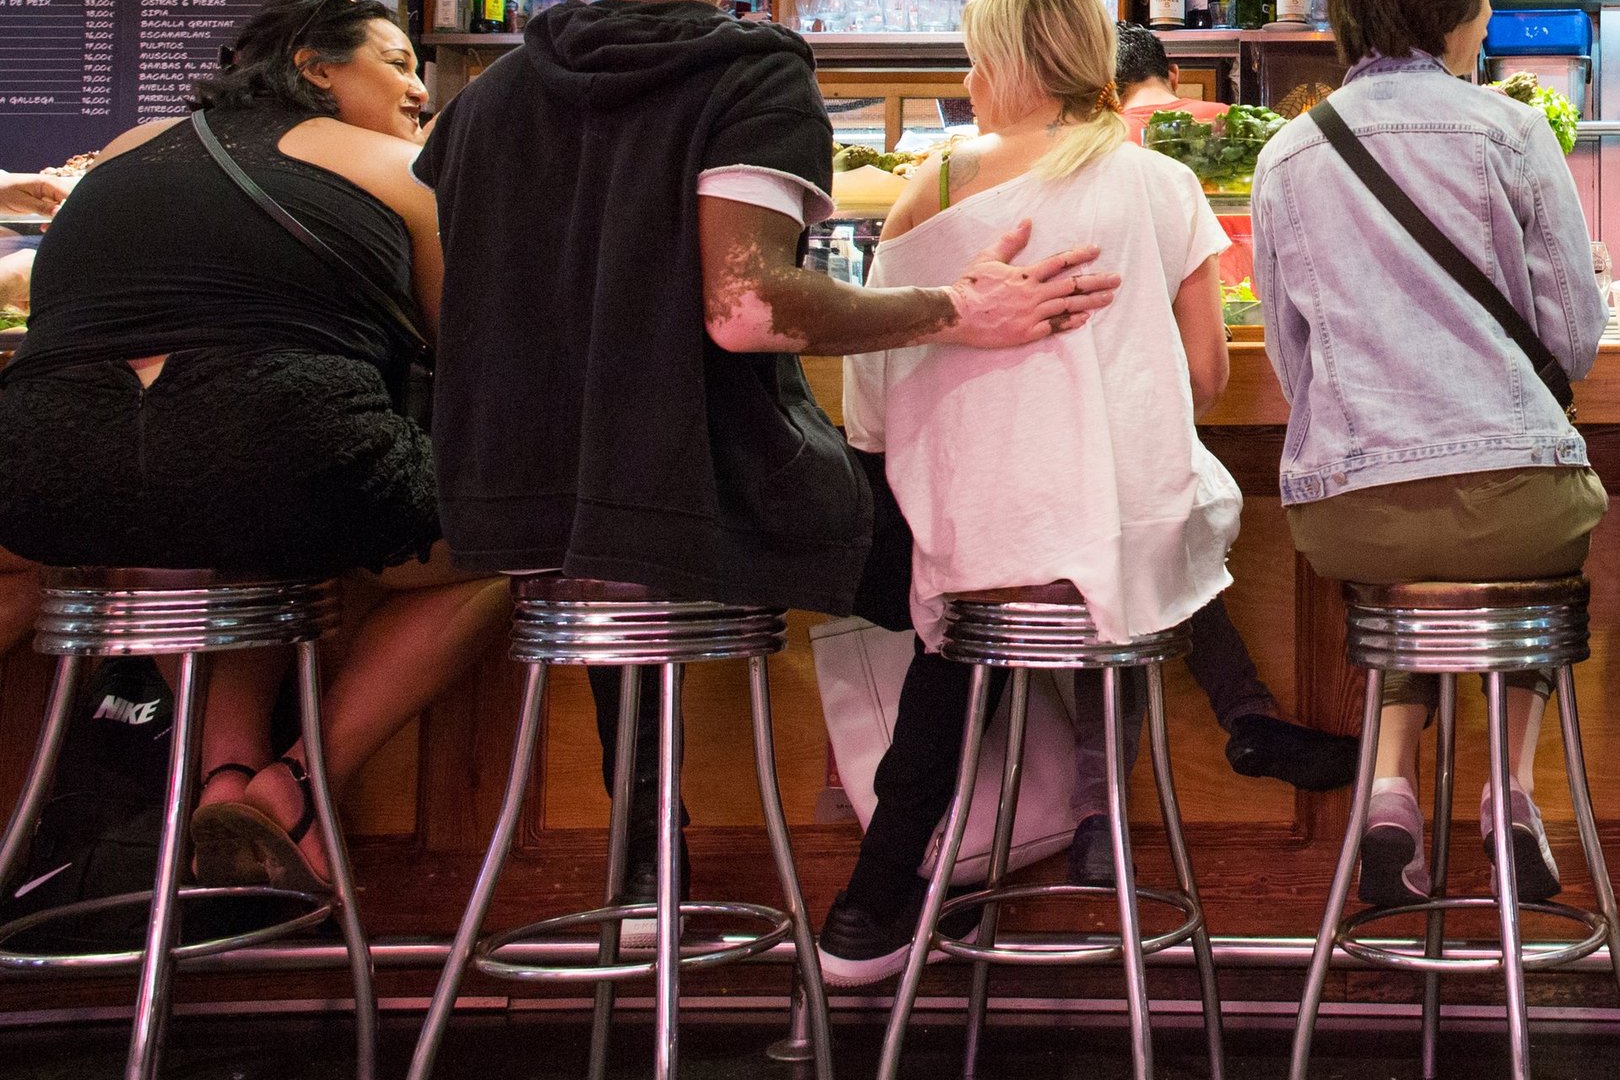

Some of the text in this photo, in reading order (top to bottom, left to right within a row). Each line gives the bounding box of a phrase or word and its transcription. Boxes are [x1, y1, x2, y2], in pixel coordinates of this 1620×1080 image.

[140, 9, 169, 17] SIPIA
[187, 20, 235, 28] GRATINAT
[139, 62, 181, 70] GAMBAS
[138, 83, 175, 91] ANELLS
[9, 96, 55, 105] GALLEGA
[92, 694, 160, 725] NIKE
